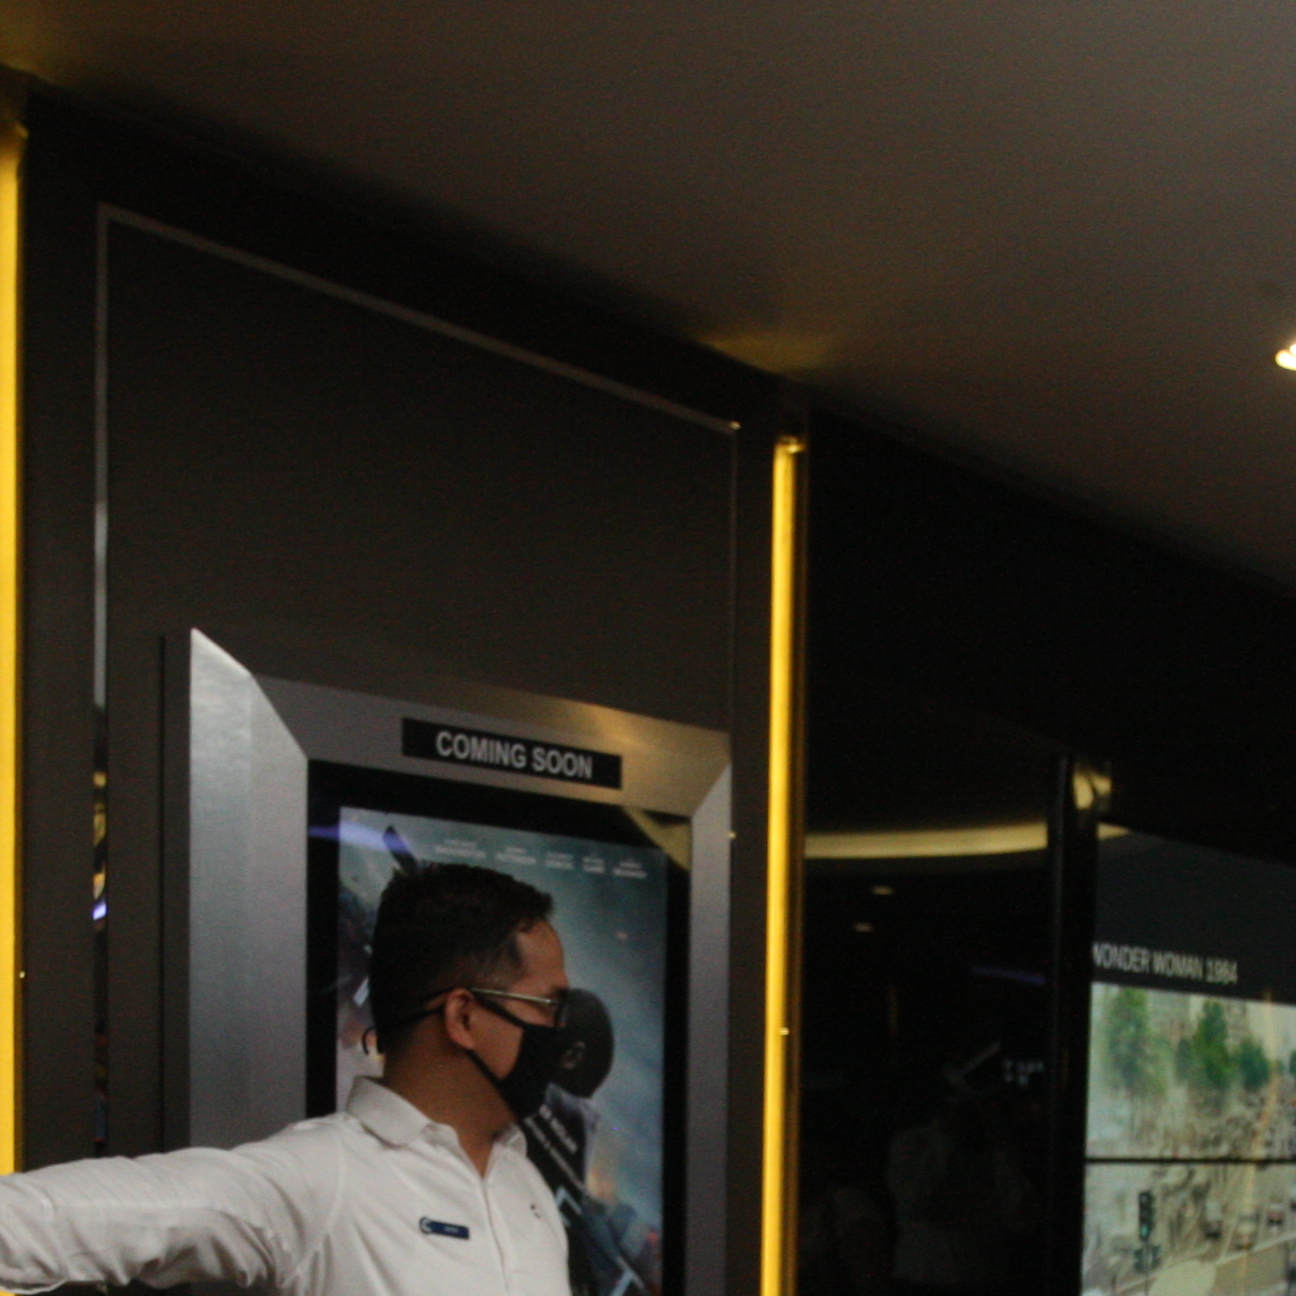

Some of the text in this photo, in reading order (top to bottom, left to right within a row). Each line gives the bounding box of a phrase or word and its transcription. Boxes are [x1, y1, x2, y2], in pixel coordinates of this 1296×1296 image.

[436, 731, 592, 779] COMING SOON
[1155, 951, 1202, 982] WOMAN
